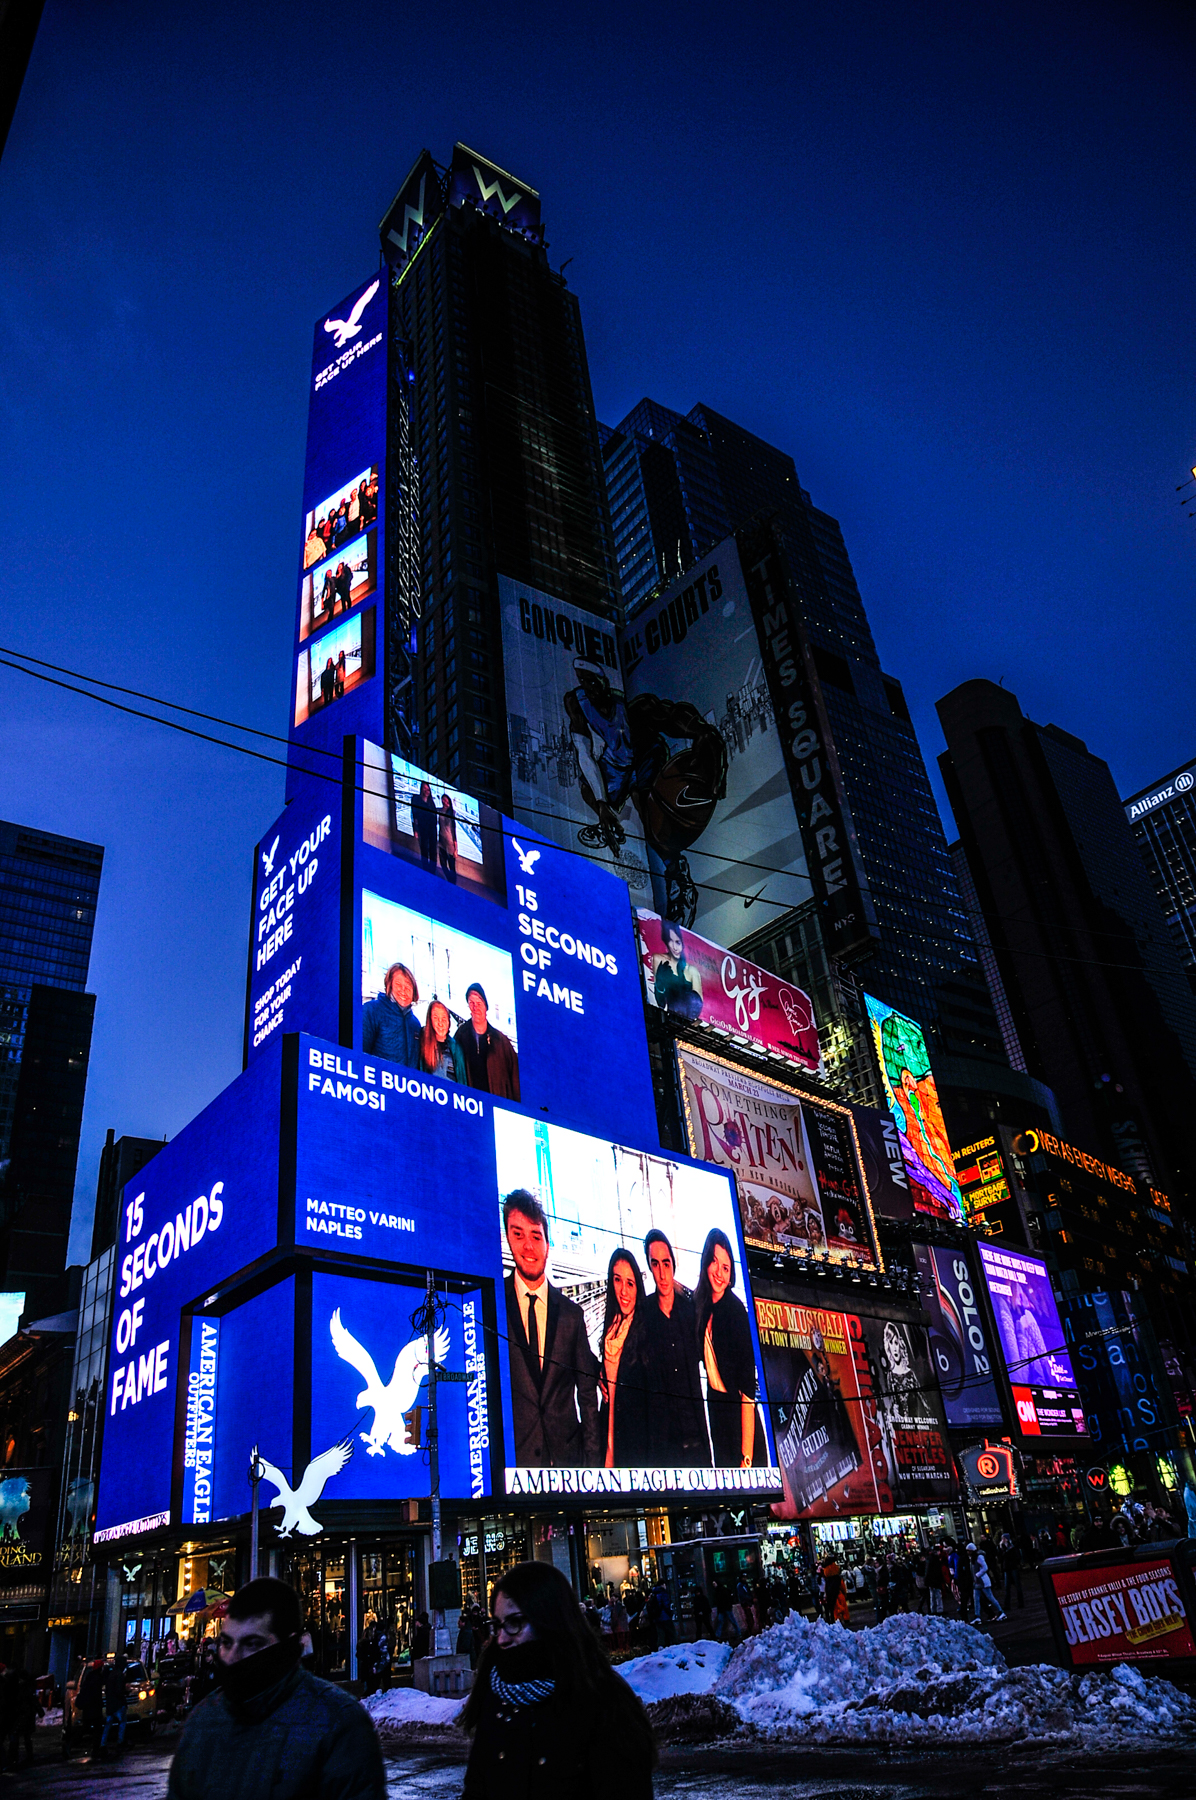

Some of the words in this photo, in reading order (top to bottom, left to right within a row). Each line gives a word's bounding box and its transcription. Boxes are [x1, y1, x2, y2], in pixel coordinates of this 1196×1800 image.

[386, 171, 427, 253] W
[471, 164, 523, 214] W
[315, 363, 334, 382] GET
[336, 341, 362, 365] YOUR
[315, 366, 340, 391] FACE
[341, 355, 355, 369] UP
[357, 333, 382, 358] HERE
[519, 598, 618, 670] CONQUER
[624, 633, 643, 665] ALL
[645, 565, 723, 655] COURTS
[751, 553, 797, 688] TIMES
[788, 700, 848, 896] SQUARE
[1130, 786, 1175, 818] Allianz
[260, 865, 287, 911] GET
[289, 814, 331, 876] YOUR
[258, 883, 295, 942] FACE
[297, 858, 318, 895] UP
[514, 883, 538, 912] 15
[834, 913, 856, 932] NYC
[256, 913, 293, 971] HERE
[518, 913, 618, 976] SECONDS
[520, 942, 552, 971] OF
[254, 985, 275, 1014] SHOP
[275, 956, 302, 991] TODAY
[254, 1009, 270, 1032] FOR
[269, 984, 292, 1014] YOUR
[522, 969, 585, 1015] FAME
[721, 955, 769, 1031] Gigi
[253, 1009, 284, 1047] CHANCE
[308, 1047, 358, 1081] BELL
[364, 1064, 376, 1086] E
[381, 1074, 448, 1107] BUONO
[453, 1092, 484, 1118] NOI
[308, 1074, 386, 1112] FAMOSI
[700, 1075, 787, 1121] SOMETHING
[727, 1079, 752, 1096] MARCH
[879, 1119, 909, 1190] NEW
[961, 1136, 995, 1159] REUTERS
[306, 1197, 366, 1225] MATTEO
[369, 1210, 416, 1233] VARINI
[969, 1180, 1007, 1201] MORTGAGE
[973, 1190, 1003, 1209] SURVEY
[120, 1180, 225, 1298] SECONDS
[125, 1191, 146, 1244] 15
[306, 1216, 363, 1241] NAPLES
[116, 1297, 146, 1355] OF
[463, 1301, 477, 1376] EAGLE
[770, 1331, 789, 1348] TONY
[789, 1333, 812, 1351] AWARD
[823, 1338, 848, 1355] WINNER
[784, 1306, 845, 1340] MUSICAL!
[953, 1259, 984, 1351] SOLO
[973, 1354, 990, 1376] 2
[110, 1339, 170, 1416] FAME
[197, 1322, 217, 1444] AMERICAN
[477, 1352, 490, 1448] OUTFITTERS
[184, 1372, 200, 1468] OUTFITTERS
[466, 1378, 484, 1499] AMERICAN
[778, 1407, 788, 1424] A
[779, 1367, 818, 1469] GENTLEMAN'S
[850, 1314, 894, 1513] CHICAGO
[894, 1430, 943, 1446] JENNIFER
[801, 1425, 830, 1457] GUIDE
[895, 1447, 947, 1465] NETTLES
[193, 1449, 213, 1524] EAGLE
[507, 1468, 622, 1494] AMERICAN
[628, 1468, 684, 1492] EAGLE
[688, 1467, 782, 1491] OUTFITTERS
[462, 1532, 505, 1557] JENS
[820, 1522, 856, 1542] GRAND
[1057, 1596, 1068, 1606] THE
[1068, 1591, 1082, 1603] STORY
[1081, 1589, 1089, 1599] OF
[1088, 1584, 1109, 1598] FRANKIE
[1107, 1580, 1121, 1593] VALLI
[1126, 1576, 1136, 1586] THE
[1135, 1572, 1149, 1584] FOUR
[1149, 1566, 1172, 1581] SEASONS
[1062, 1591, 1132, 1646] JERSEY
[1127, 1577, 1186, 1627] BOYS
